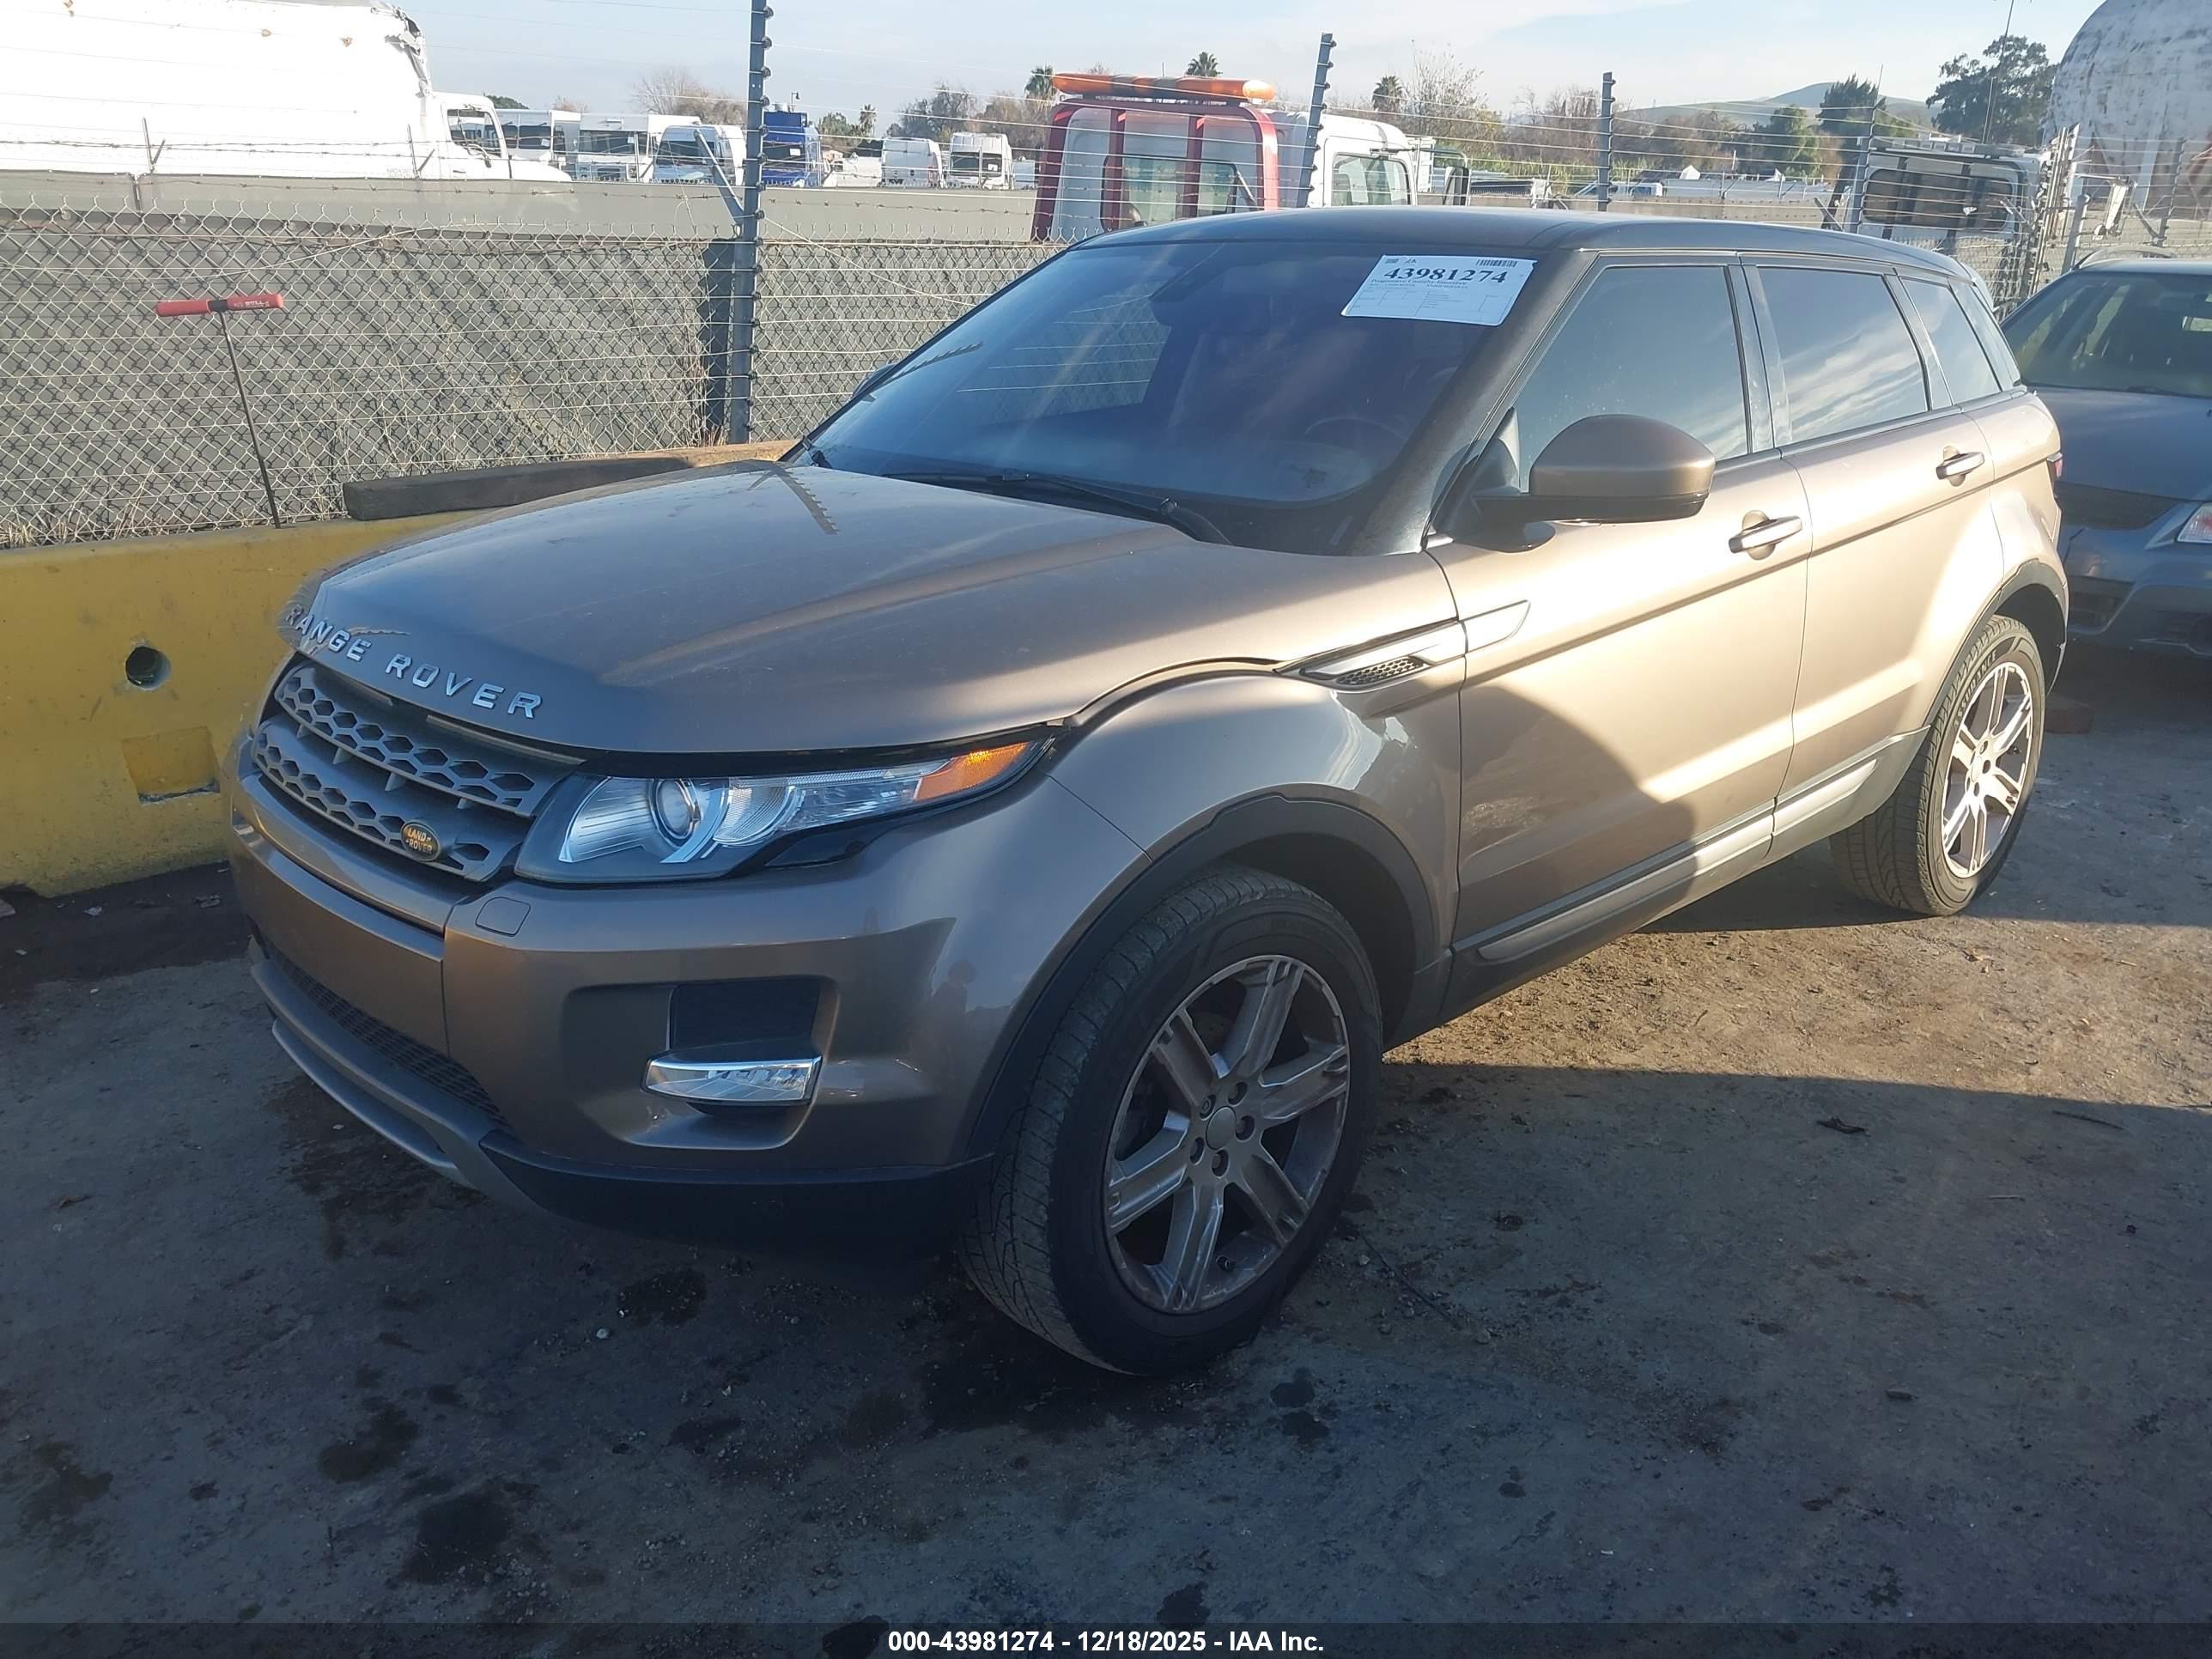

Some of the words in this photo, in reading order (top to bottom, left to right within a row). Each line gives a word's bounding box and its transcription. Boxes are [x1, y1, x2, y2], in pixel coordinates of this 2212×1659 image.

[1383, 267, 1509, 283] 43981274
[285, 604, 373, 662] RANGE
[385, 653, 542, 719] ROVER
[407, 827, 427, 842] LAND
